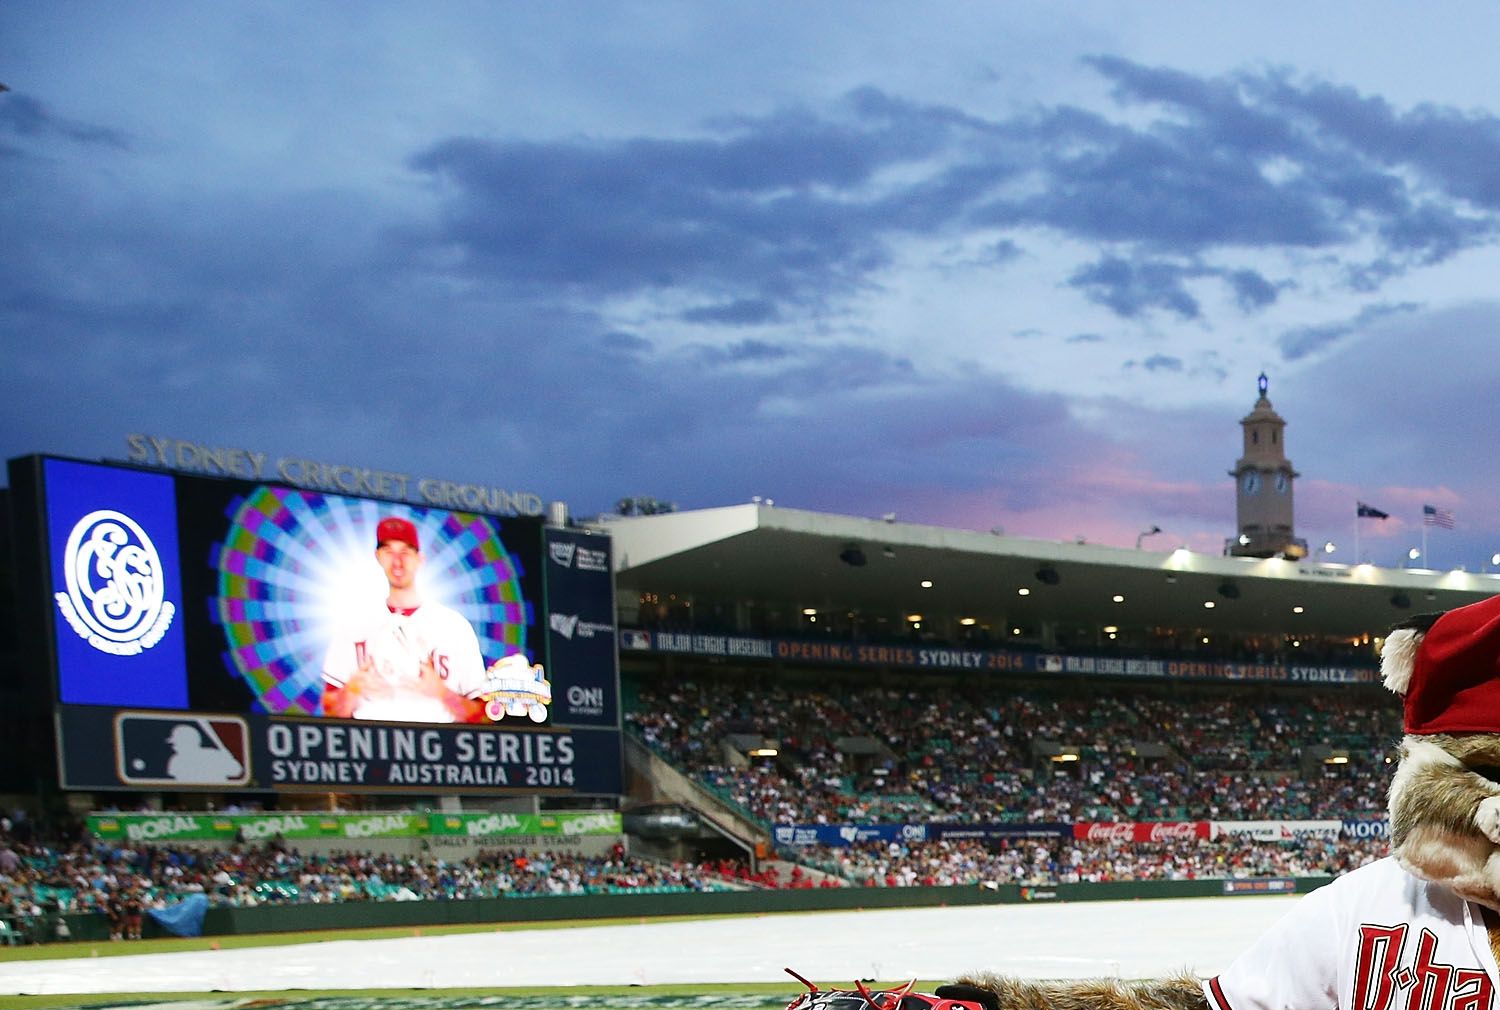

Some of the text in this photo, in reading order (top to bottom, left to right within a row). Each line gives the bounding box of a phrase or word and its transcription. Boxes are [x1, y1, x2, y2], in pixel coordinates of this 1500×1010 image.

[126, 433, 544, 517] SYDNEY CRICKET GROUND
[778, 642, 1024, 669] OPENING SERIES SYDNEY 2014
[1168, 662, 1233, 678] OPENING
[1236, 664, 1287, 680] SERIES
[1291, 667, 1347, 682] SYDNEY
[567, 685, 603, 706] ON!
[267, 724, 575, 765] OPENING SERIES
[271, 760, 575, 786] SYDNEY AUSTRALIA 2014
[127, 816, 200, 841] BORAL
[240, 816, 309, 838] BORAL
[344, 815, 409, 838] BORAL
[466, 814, 521, 836] BORAL
[562, 813, 619, 835] BORAL
[1088, 822, 1136, 841] Coca-Cola
[1150, 822, 1199, 841] Coca-Cola
